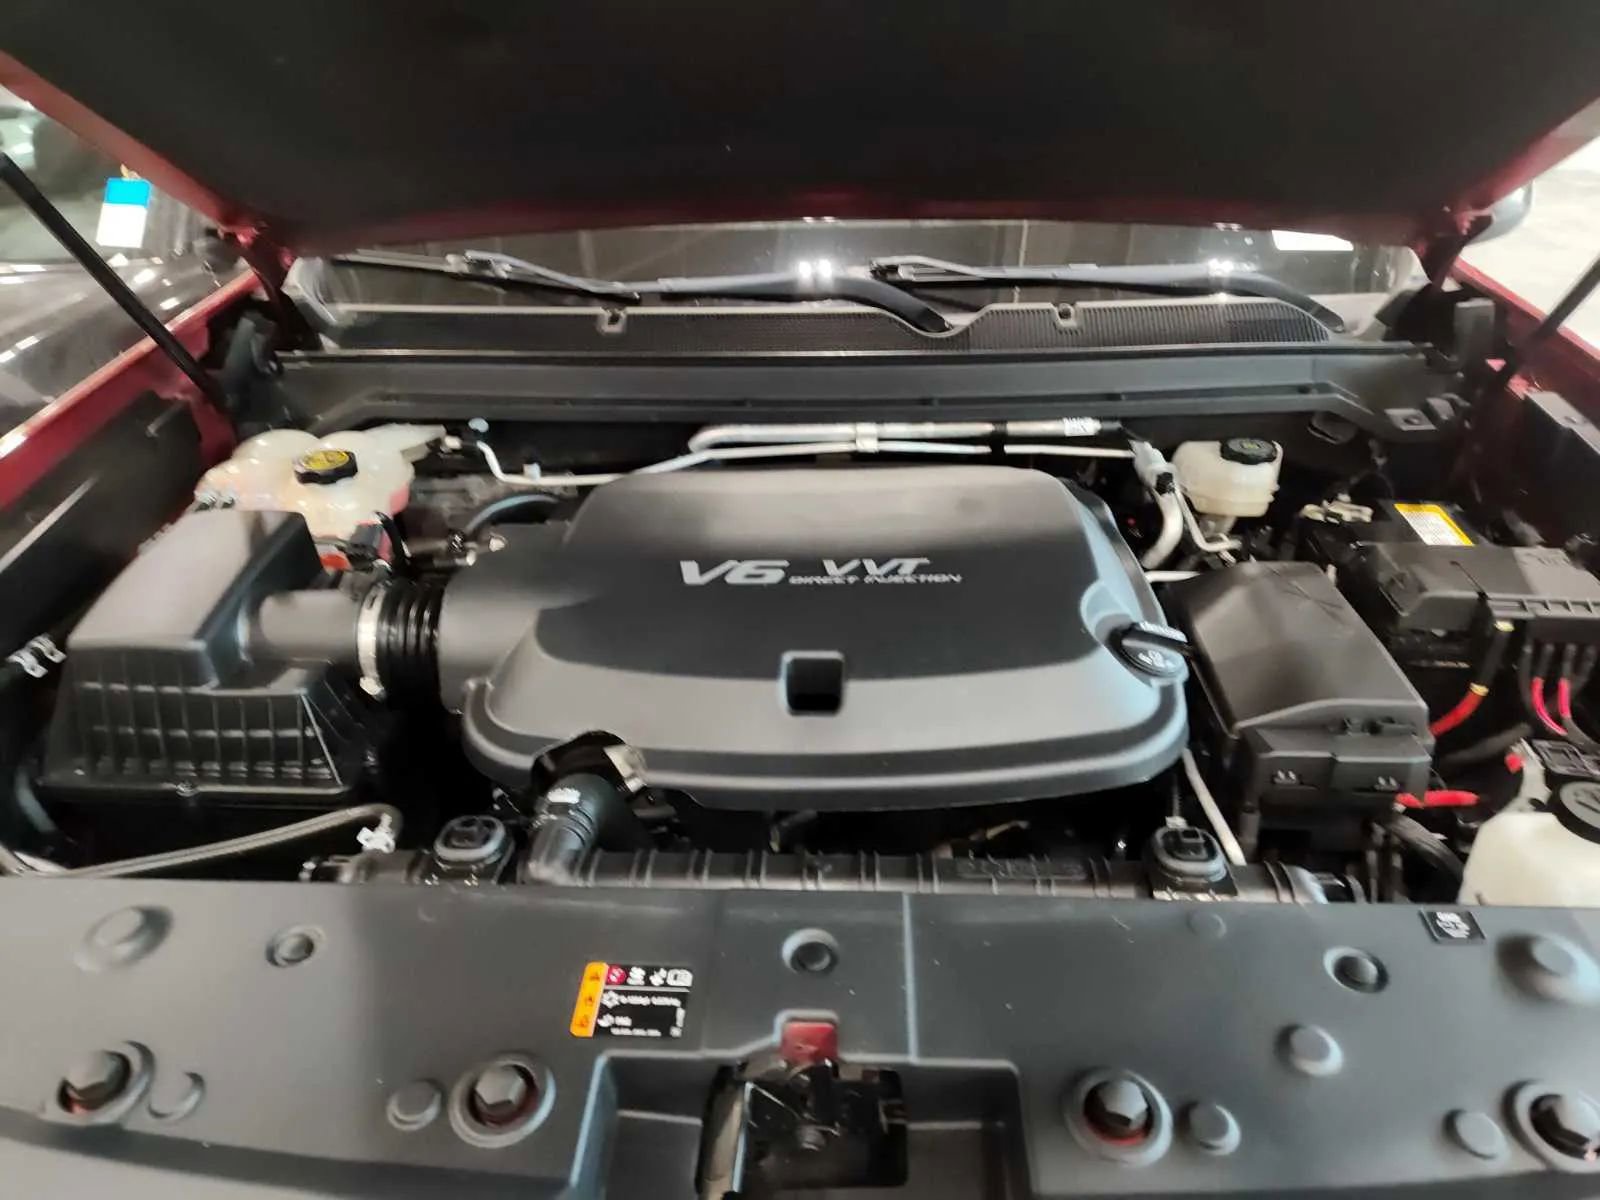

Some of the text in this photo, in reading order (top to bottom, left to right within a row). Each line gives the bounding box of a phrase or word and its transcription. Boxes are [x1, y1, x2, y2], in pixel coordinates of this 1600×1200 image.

[680, 559, 790, 585] V6
[822, 557, 931, 576] VVT
[788, 575, 860, 585] DIRECT
